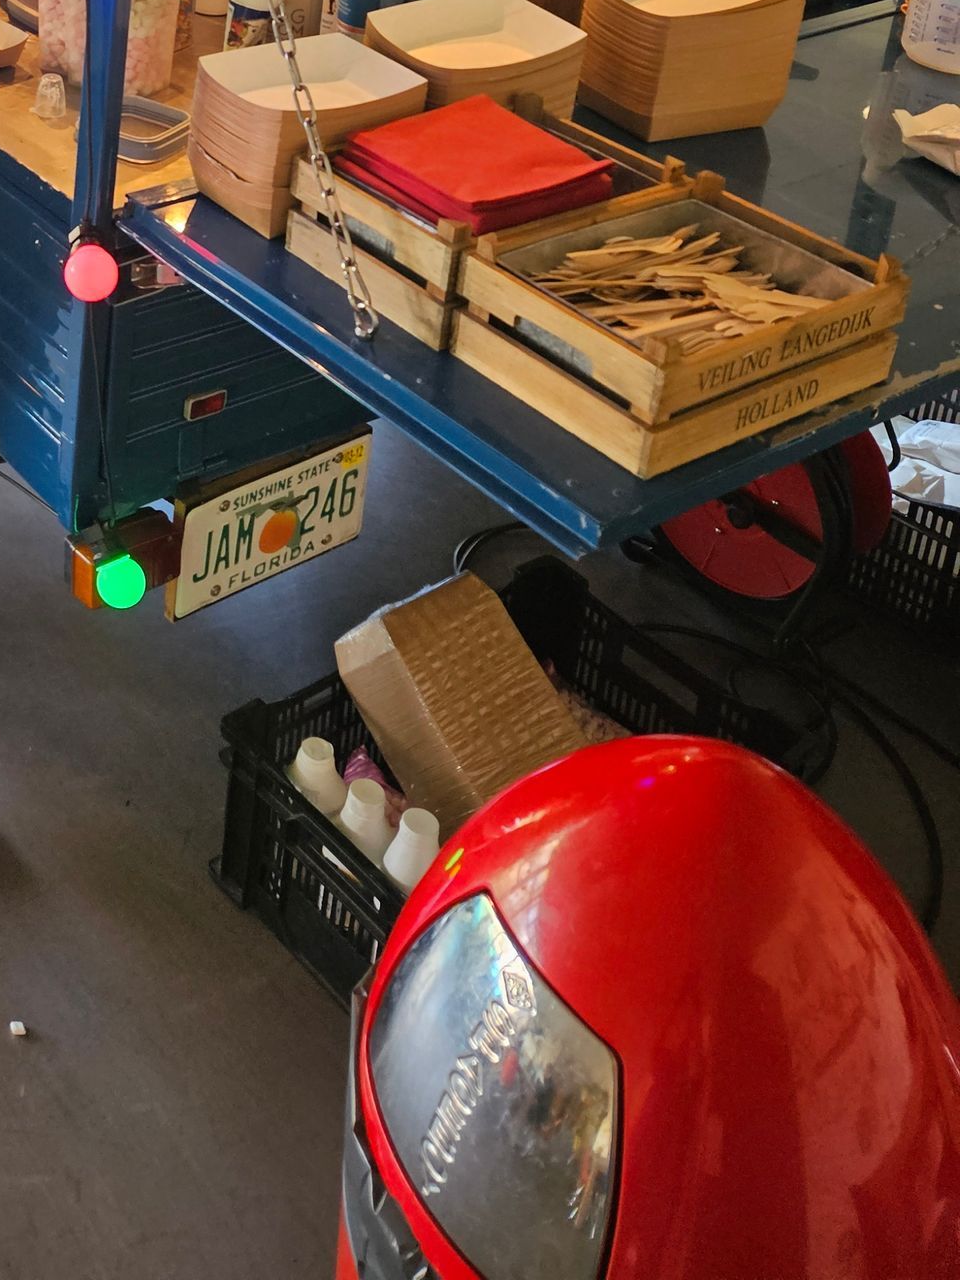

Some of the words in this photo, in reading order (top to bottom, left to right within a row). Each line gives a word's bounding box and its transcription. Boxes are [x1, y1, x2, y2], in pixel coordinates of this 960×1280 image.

[697, 347, 773, 393] VEILING
[778, 306, 876, 361] LANGEDIJK
[733, 379, 820, 431] HOLLAND
[232, 475, 293, 511] SUNSHINE
[297, 460, 331, 484] STATE
[192, 512, 257, 583] JAM
[300, 468, 359, 535] 246
[227, 539, 315, 589] FLORIDA
